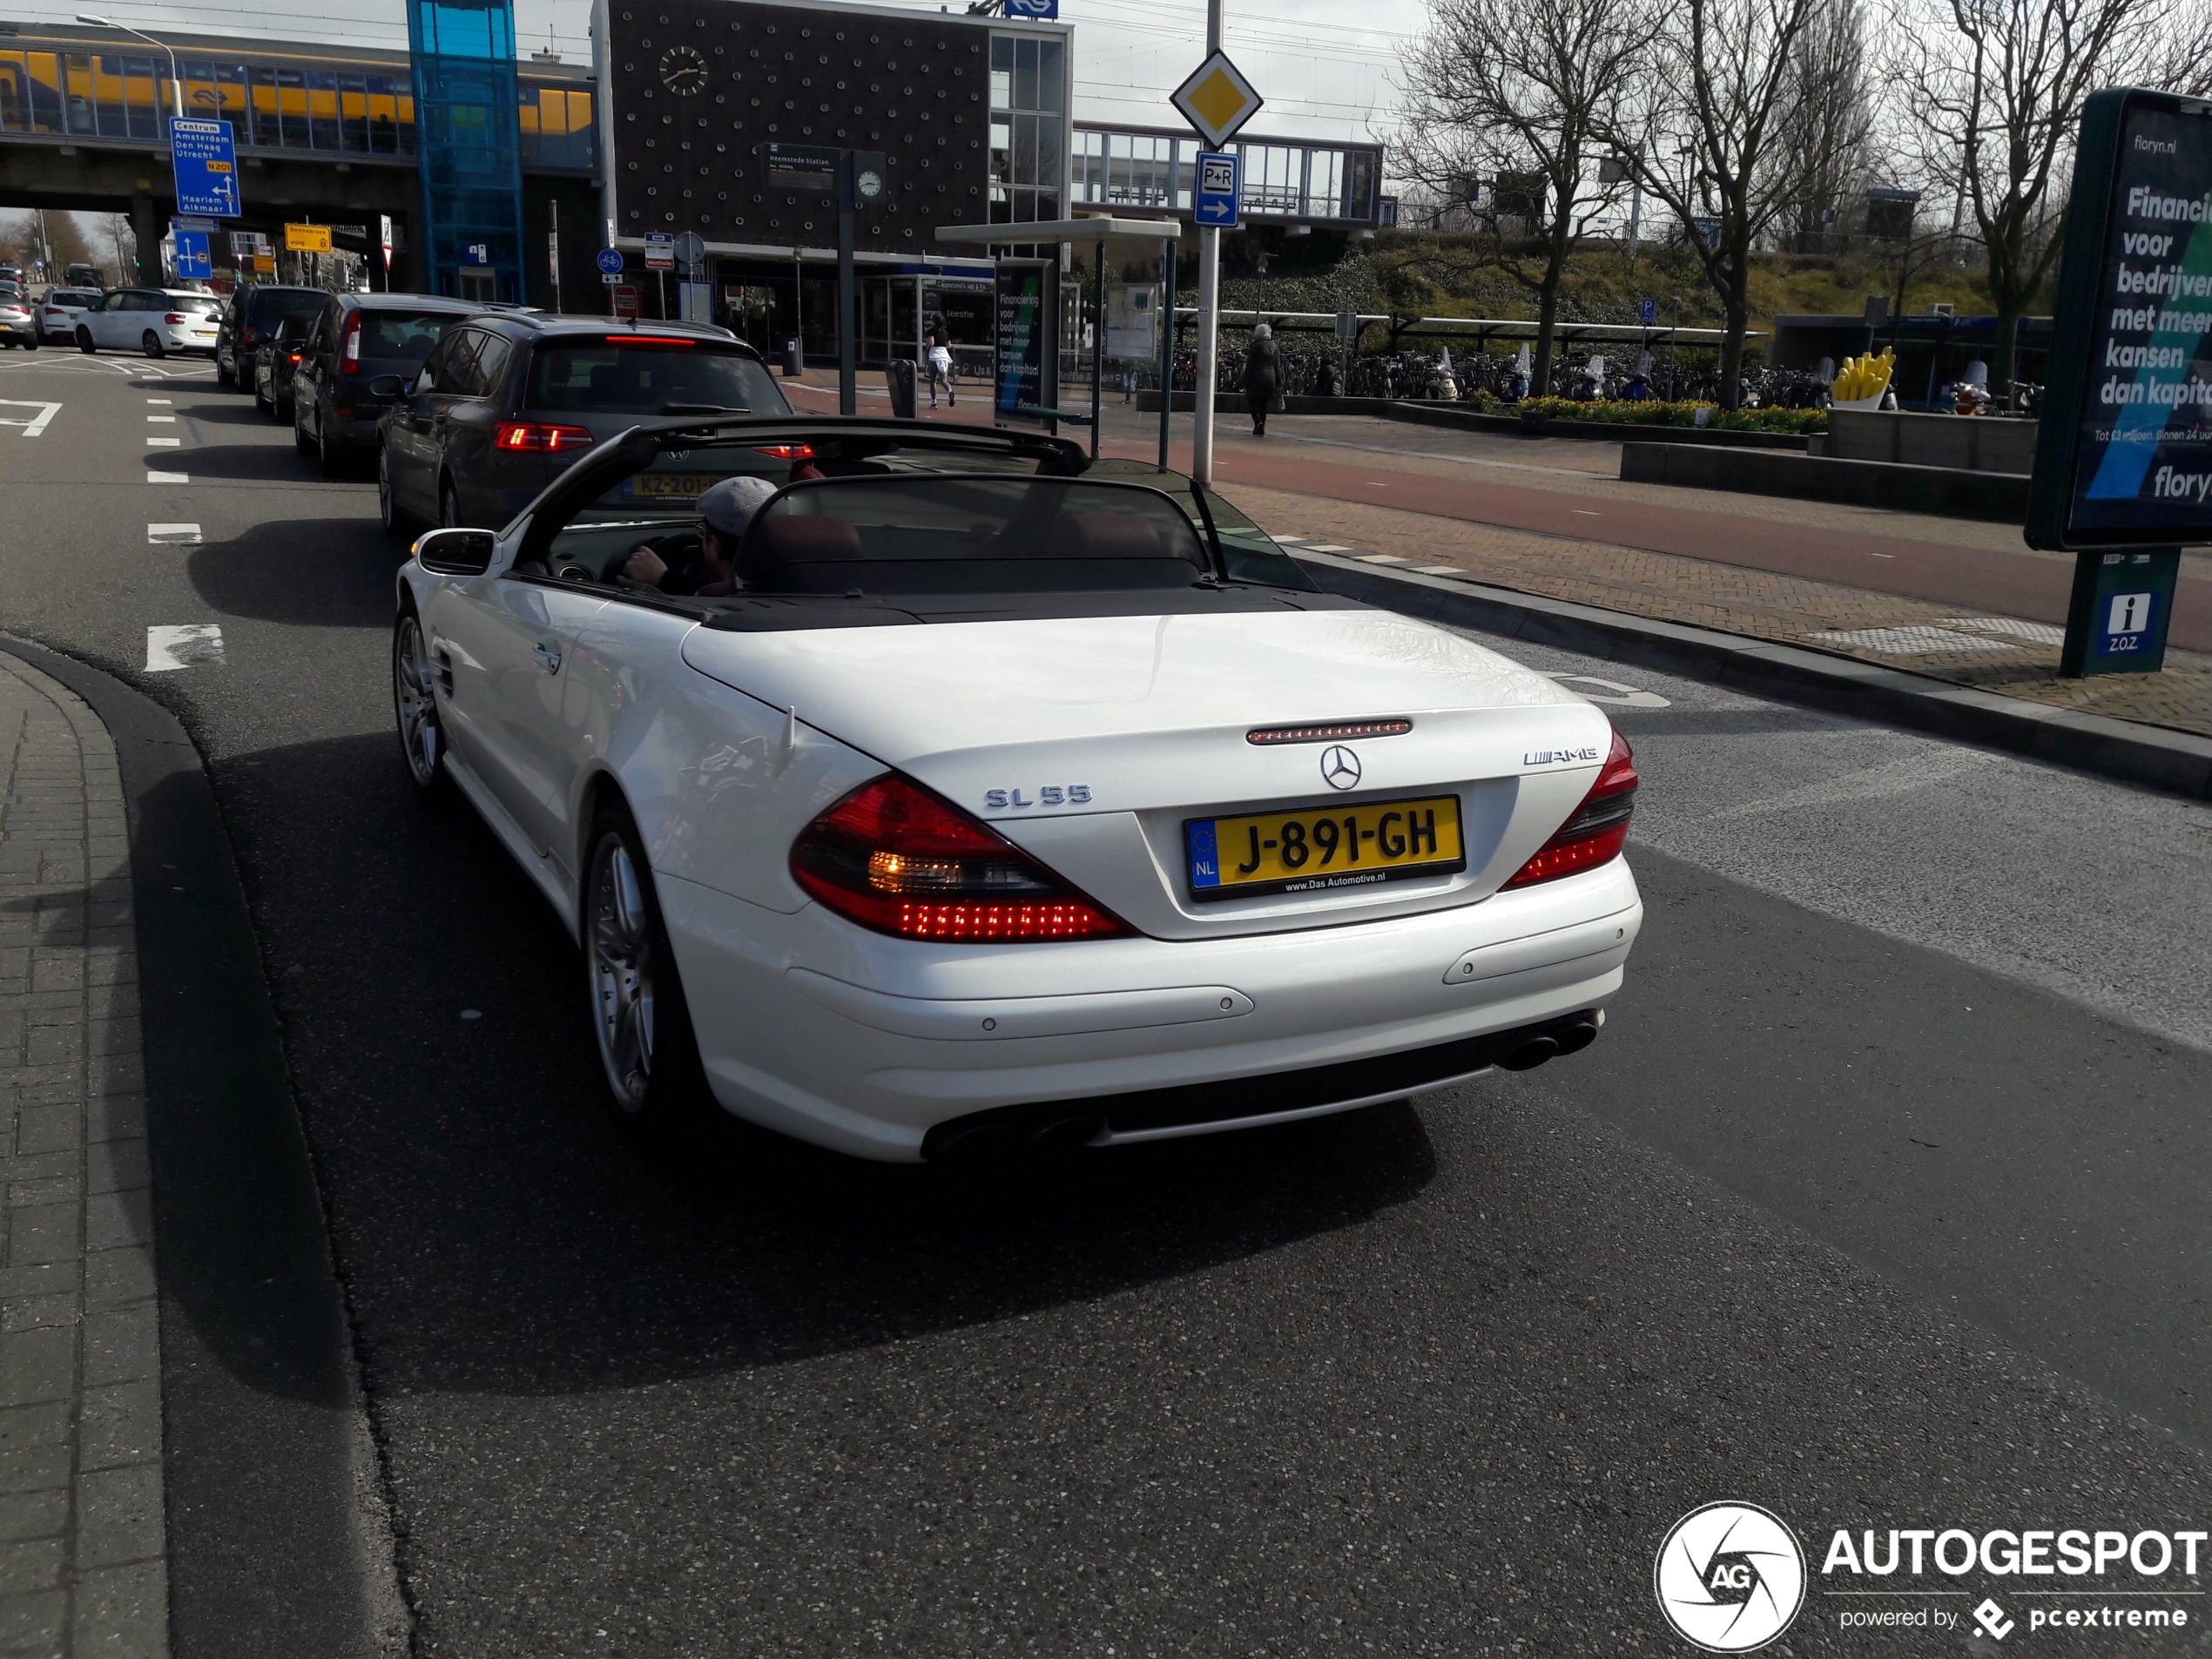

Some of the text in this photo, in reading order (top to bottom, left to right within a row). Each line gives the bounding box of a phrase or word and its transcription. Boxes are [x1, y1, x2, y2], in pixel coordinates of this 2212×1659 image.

[177, 122, 218, 132] Centrum
[175, 132, 229, 143] Amsterdam
[2134, 134, 2176, 154] floryn.nl
[176, 150, 213, 158] Utrecht
[197, 142, 221, 153] Haag
[769, 155, 805, 164] Heemstede
[1204, 168, 1232, 185] P+R
[182, 195, 222, 204] Haarlem
[184, 204, 224, 212] Alkmaar
[2123, 232, 2174, 257] voor
[1000, 293, 1039, 307] Financiering
[1644, 300, 1653, 312] P
[947, 309, 974, 319] teestie
[1000, 309, 1015, 319] voor
[2111, 304, 2156, 331] met
[999, 321, 1029, 336] bedrijven
[999, 336, 1030, 347] met meer
[999, 349, 1022, 361] kansen
[2105, 337, 2184, 368] kansen
[999, 363, 1039, 377] dan kapitaal
[2101, 374, 2144, 405] dan
[2095, 428, 2212, 442] Tot €3 miljoen. Binnen 24 uur
[2155, 465, 2212, 502] flory
[1550, 746, 1599, 764] AMG
[987, 785, 1093, 807] SL 55
[1239, 808, 1437, 873] J-891-GH
[1196, 860, 1215, 876] NL
[1285, 872, 1386, 892] www.Das Automotive.nl
